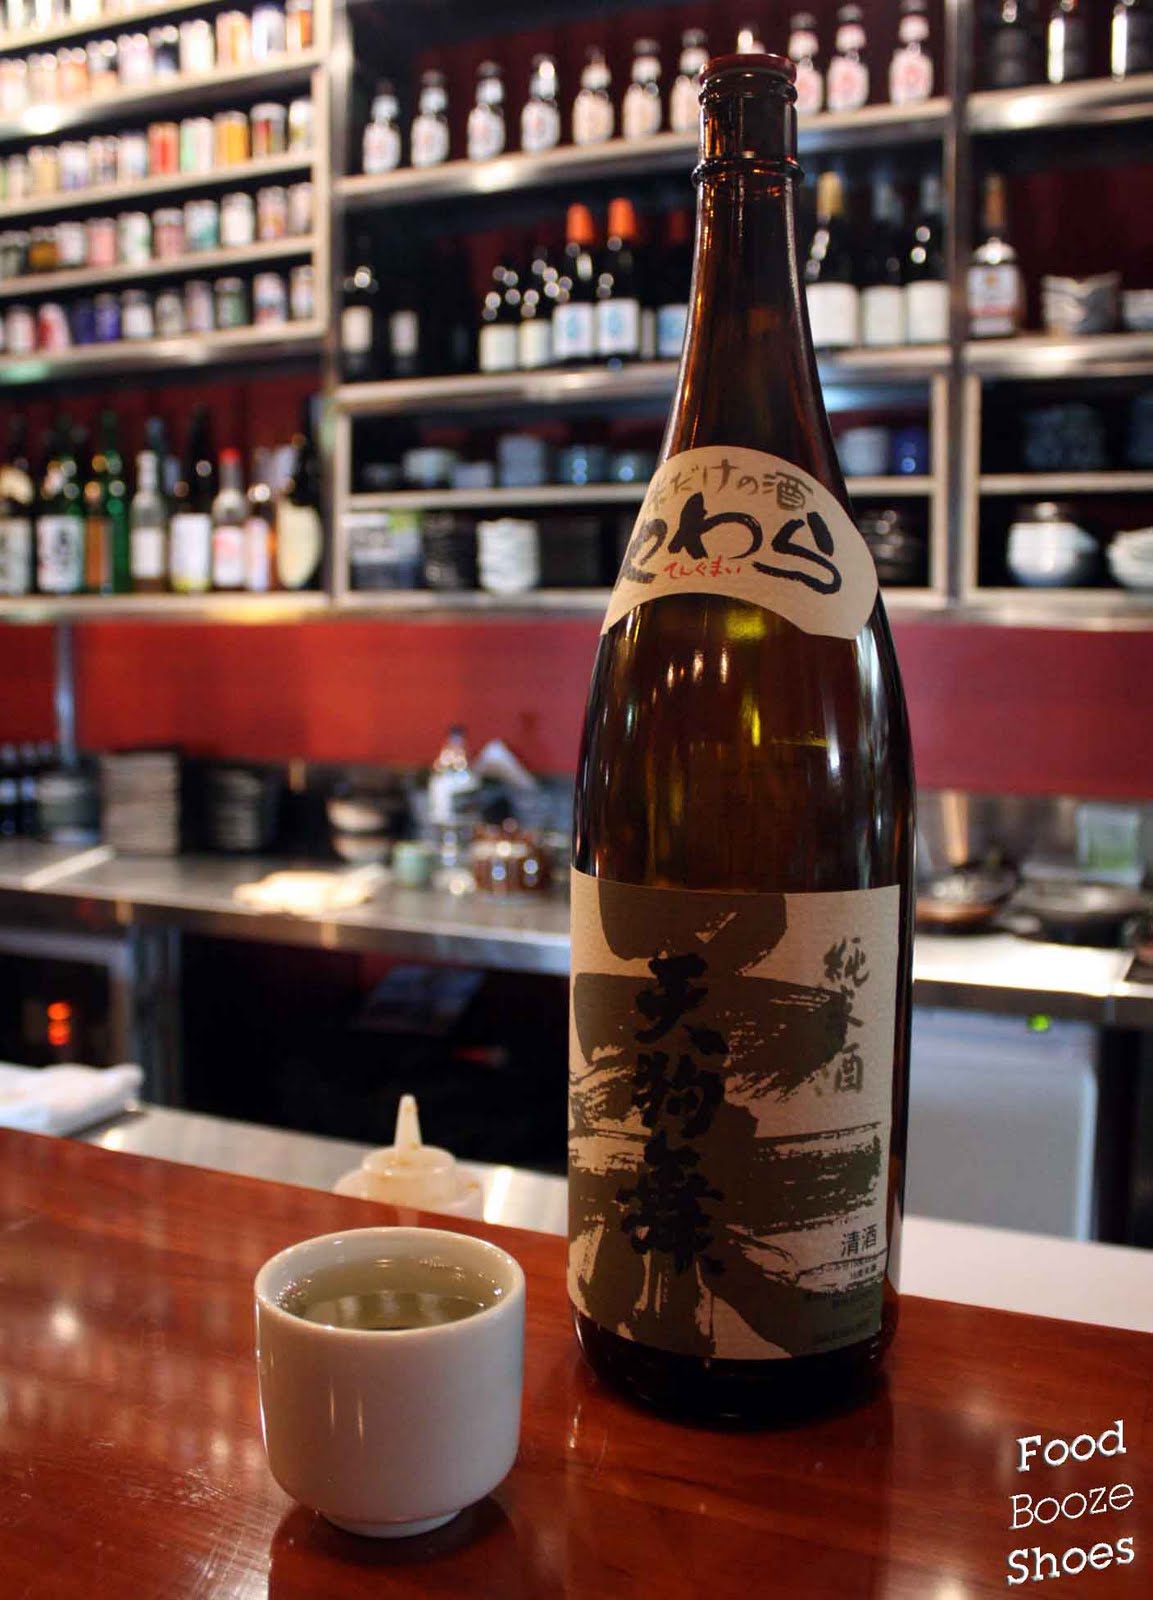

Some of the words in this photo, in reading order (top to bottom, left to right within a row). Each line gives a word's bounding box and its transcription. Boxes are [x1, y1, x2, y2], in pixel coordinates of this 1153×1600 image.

[663, 555, 742, 578] てんぐまい
[840, 1223, 878, 1258] 清酒
